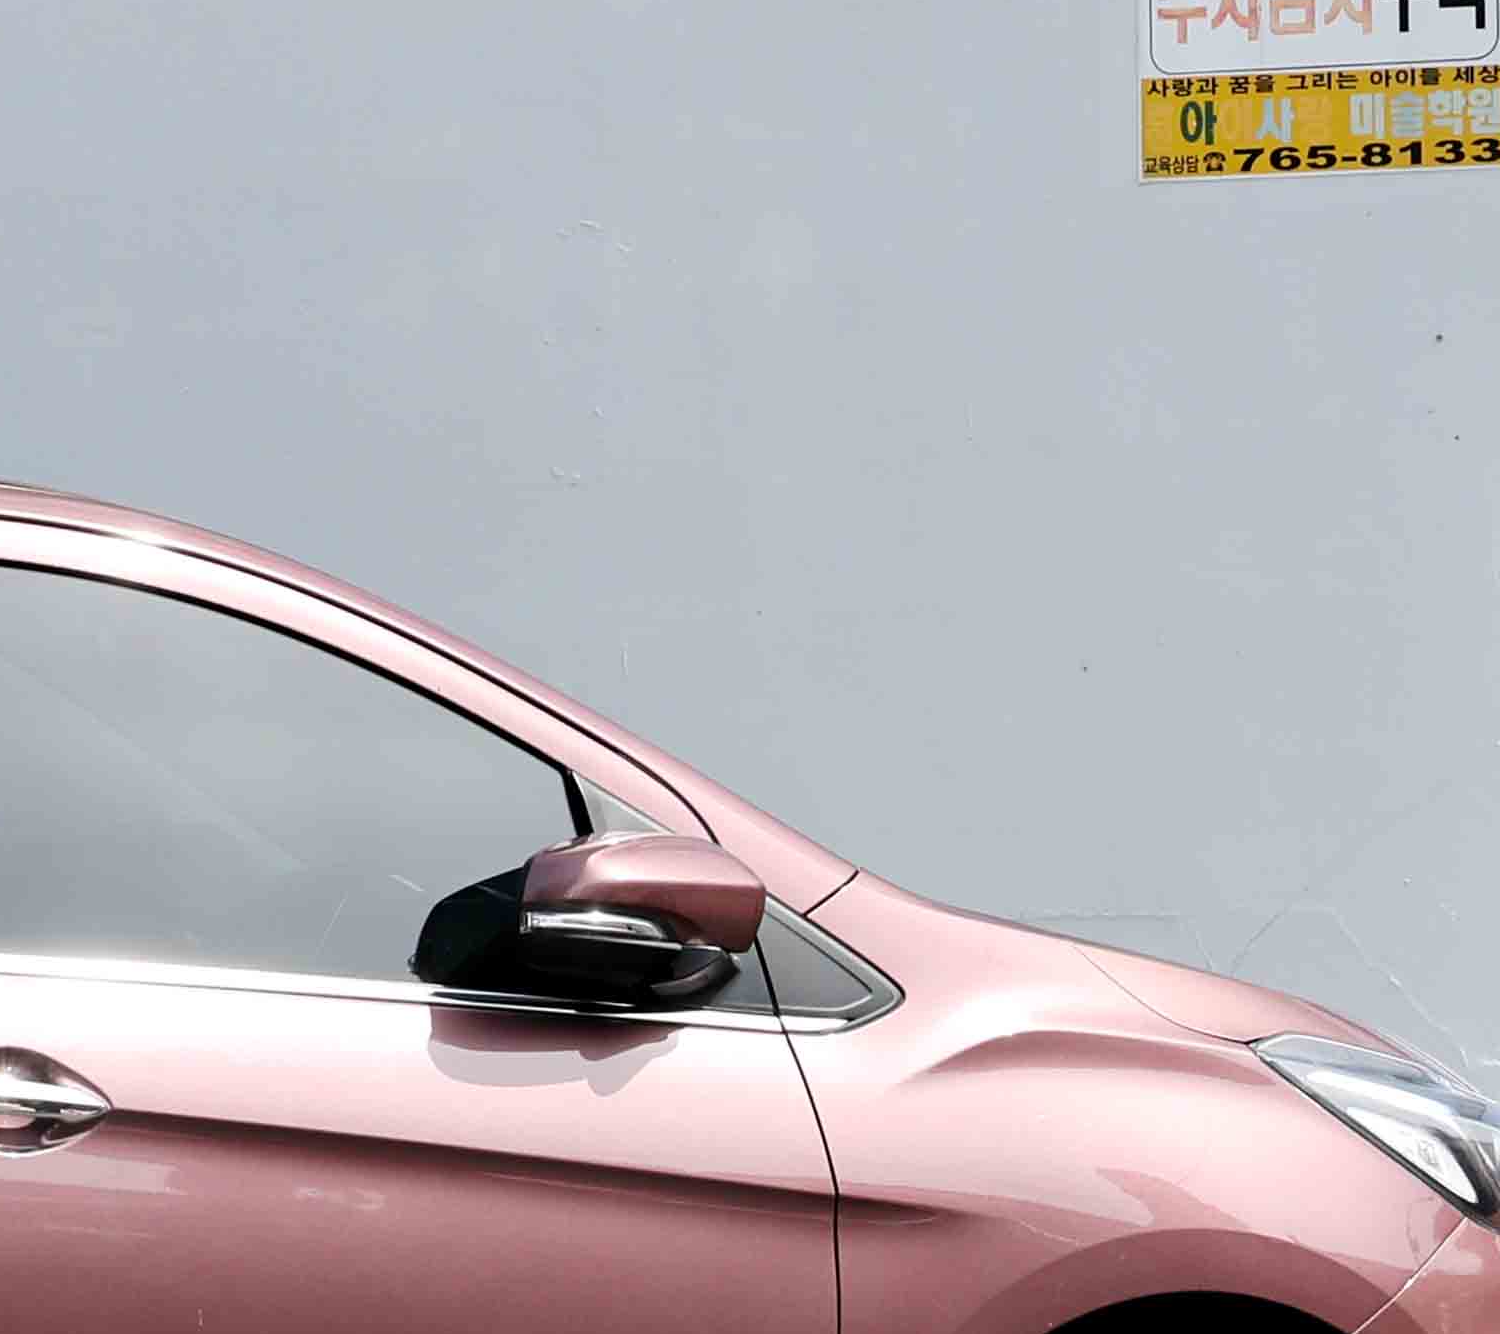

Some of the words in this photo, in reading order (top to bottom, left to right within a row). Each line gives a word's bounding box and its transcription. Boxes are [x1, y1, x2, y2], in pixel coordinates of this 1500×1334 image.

[1147, 77, 1219, 97] 사랑과
[1229, 75, 1275, 94] 꿈을
[1286, 71, 1359, 90] 그리는
[1370, 67, 1443, 86] 아이들
[1453, 64, 1500, 83] 세상
[1144, 155, 1199, 175] 교육상담
